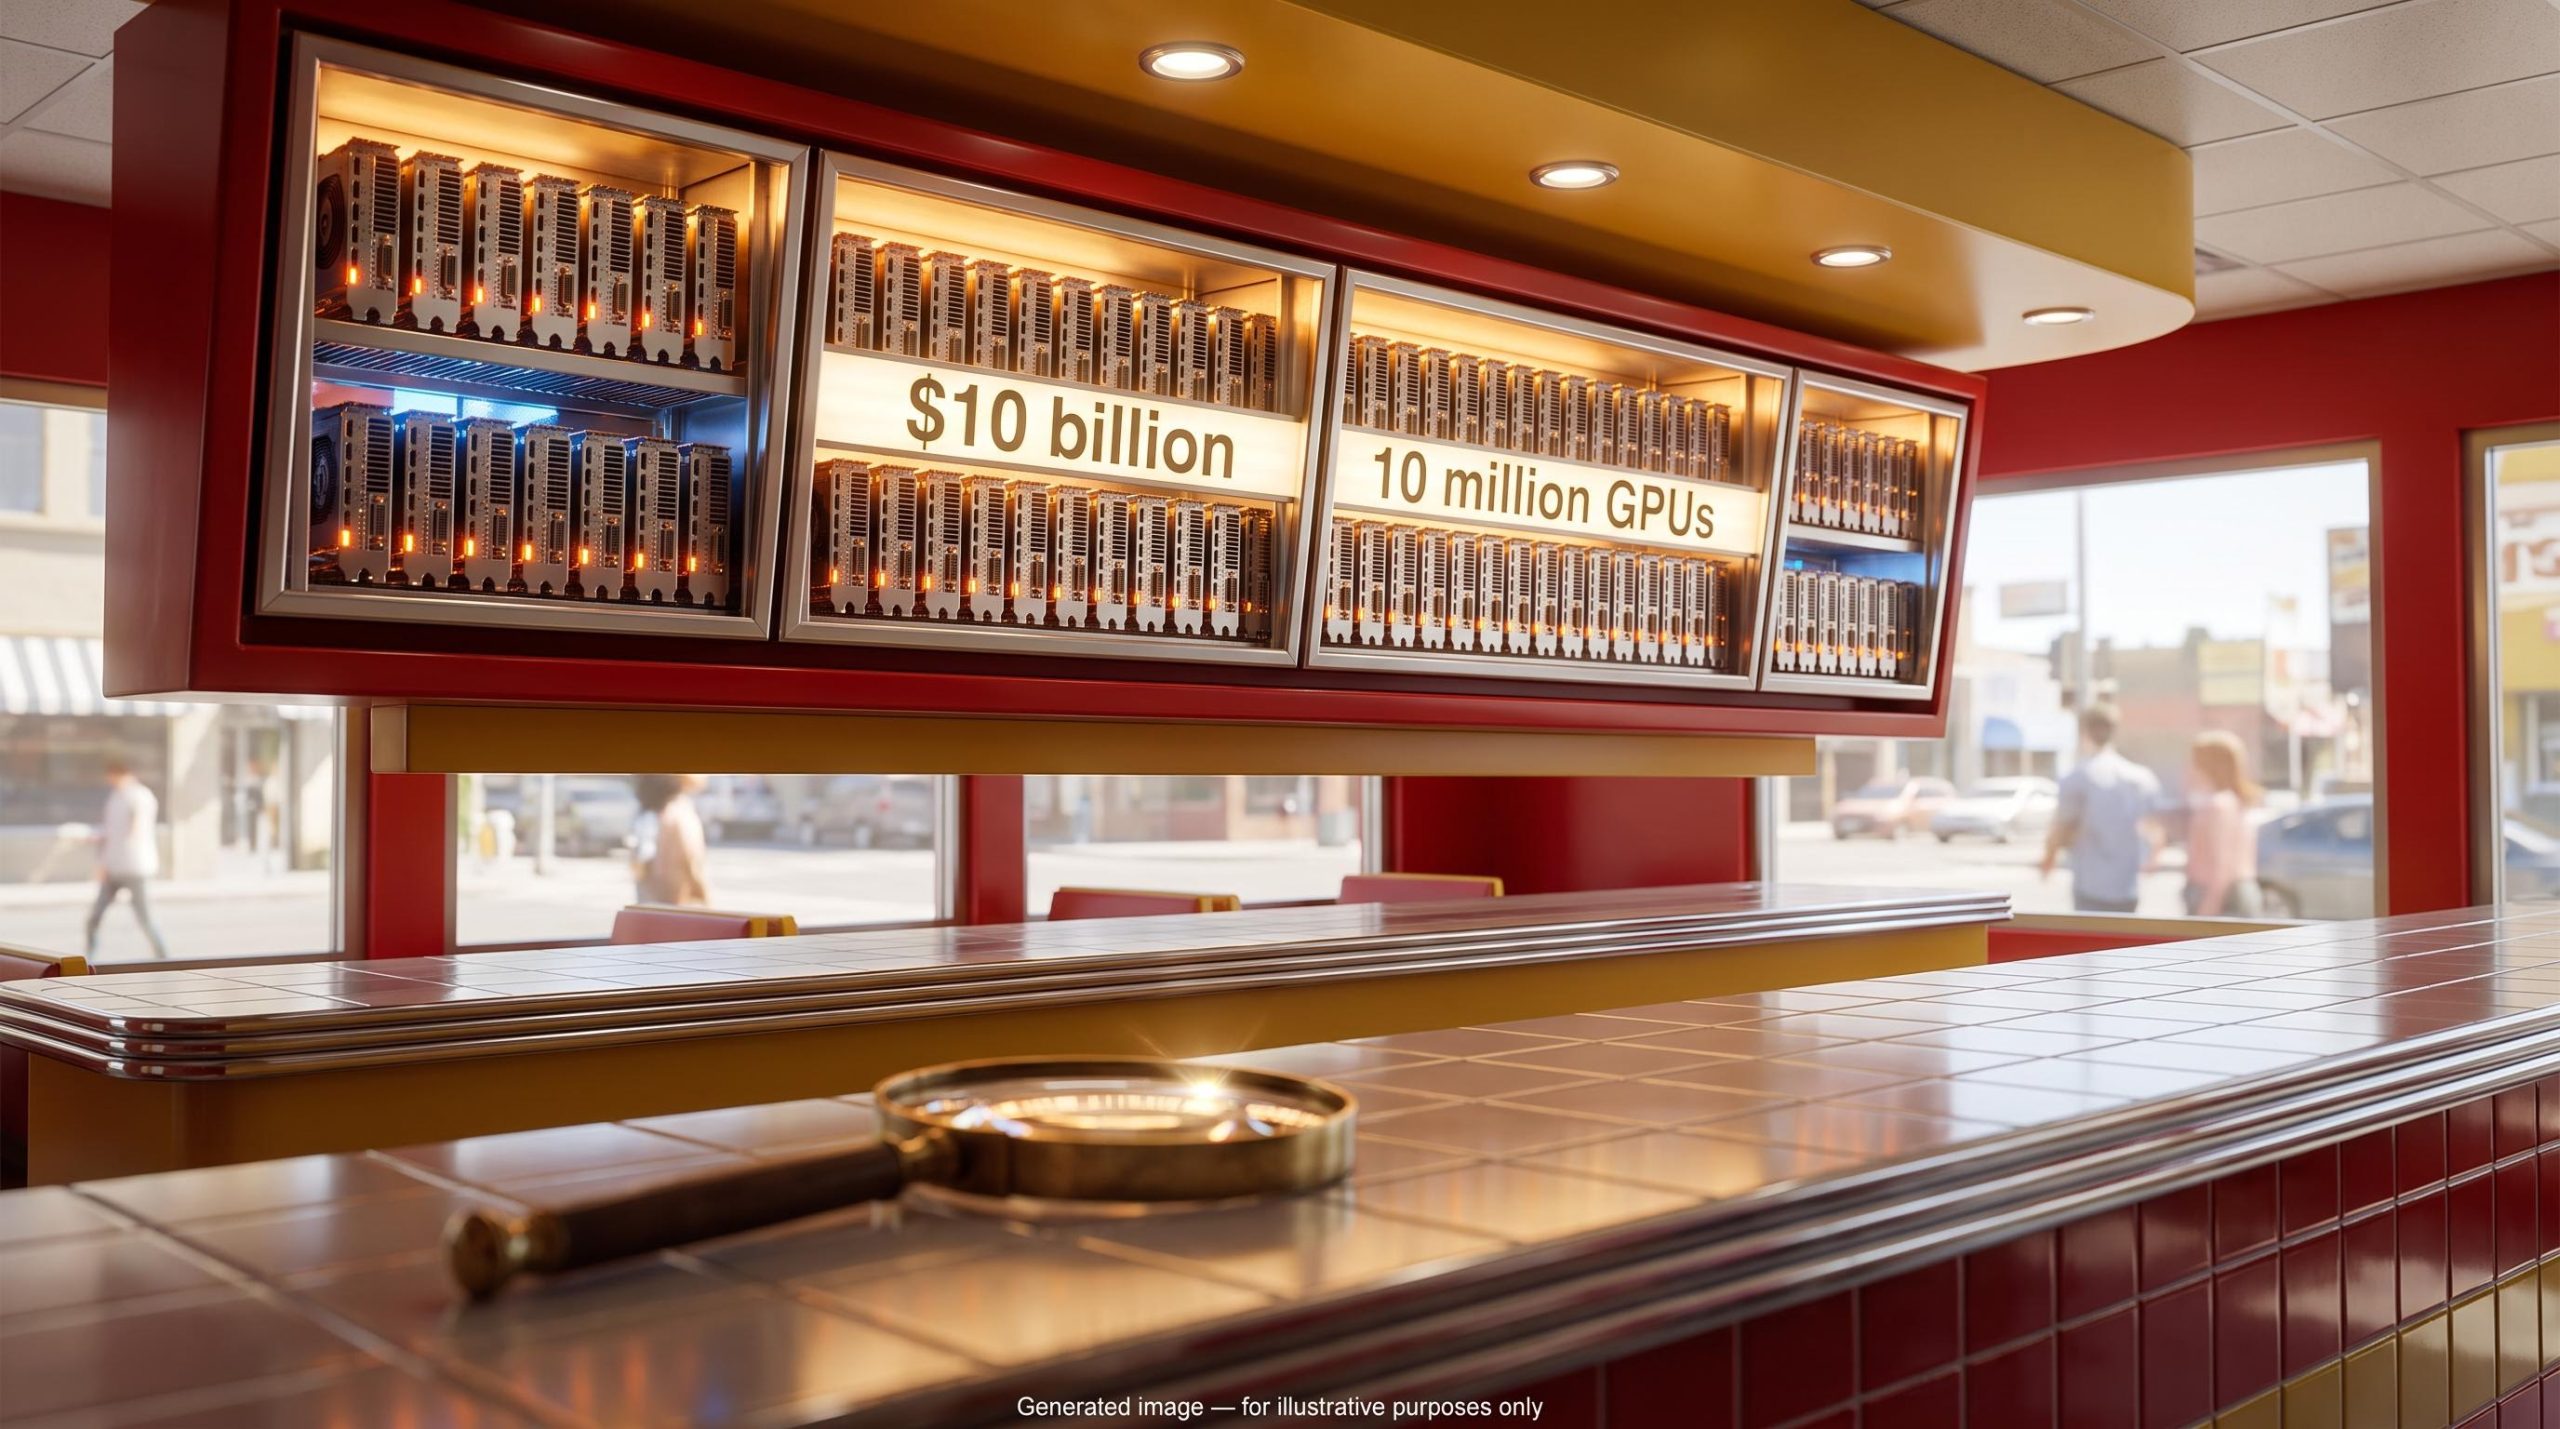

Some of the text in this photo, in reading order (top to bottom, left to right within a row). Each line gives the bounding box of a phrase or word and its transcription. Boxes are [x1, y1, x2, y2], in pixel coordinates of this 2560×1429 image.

[906, 372, 1234, 479] $10 billion
[1374, 446, 1714, 539] 10 million GPUs
